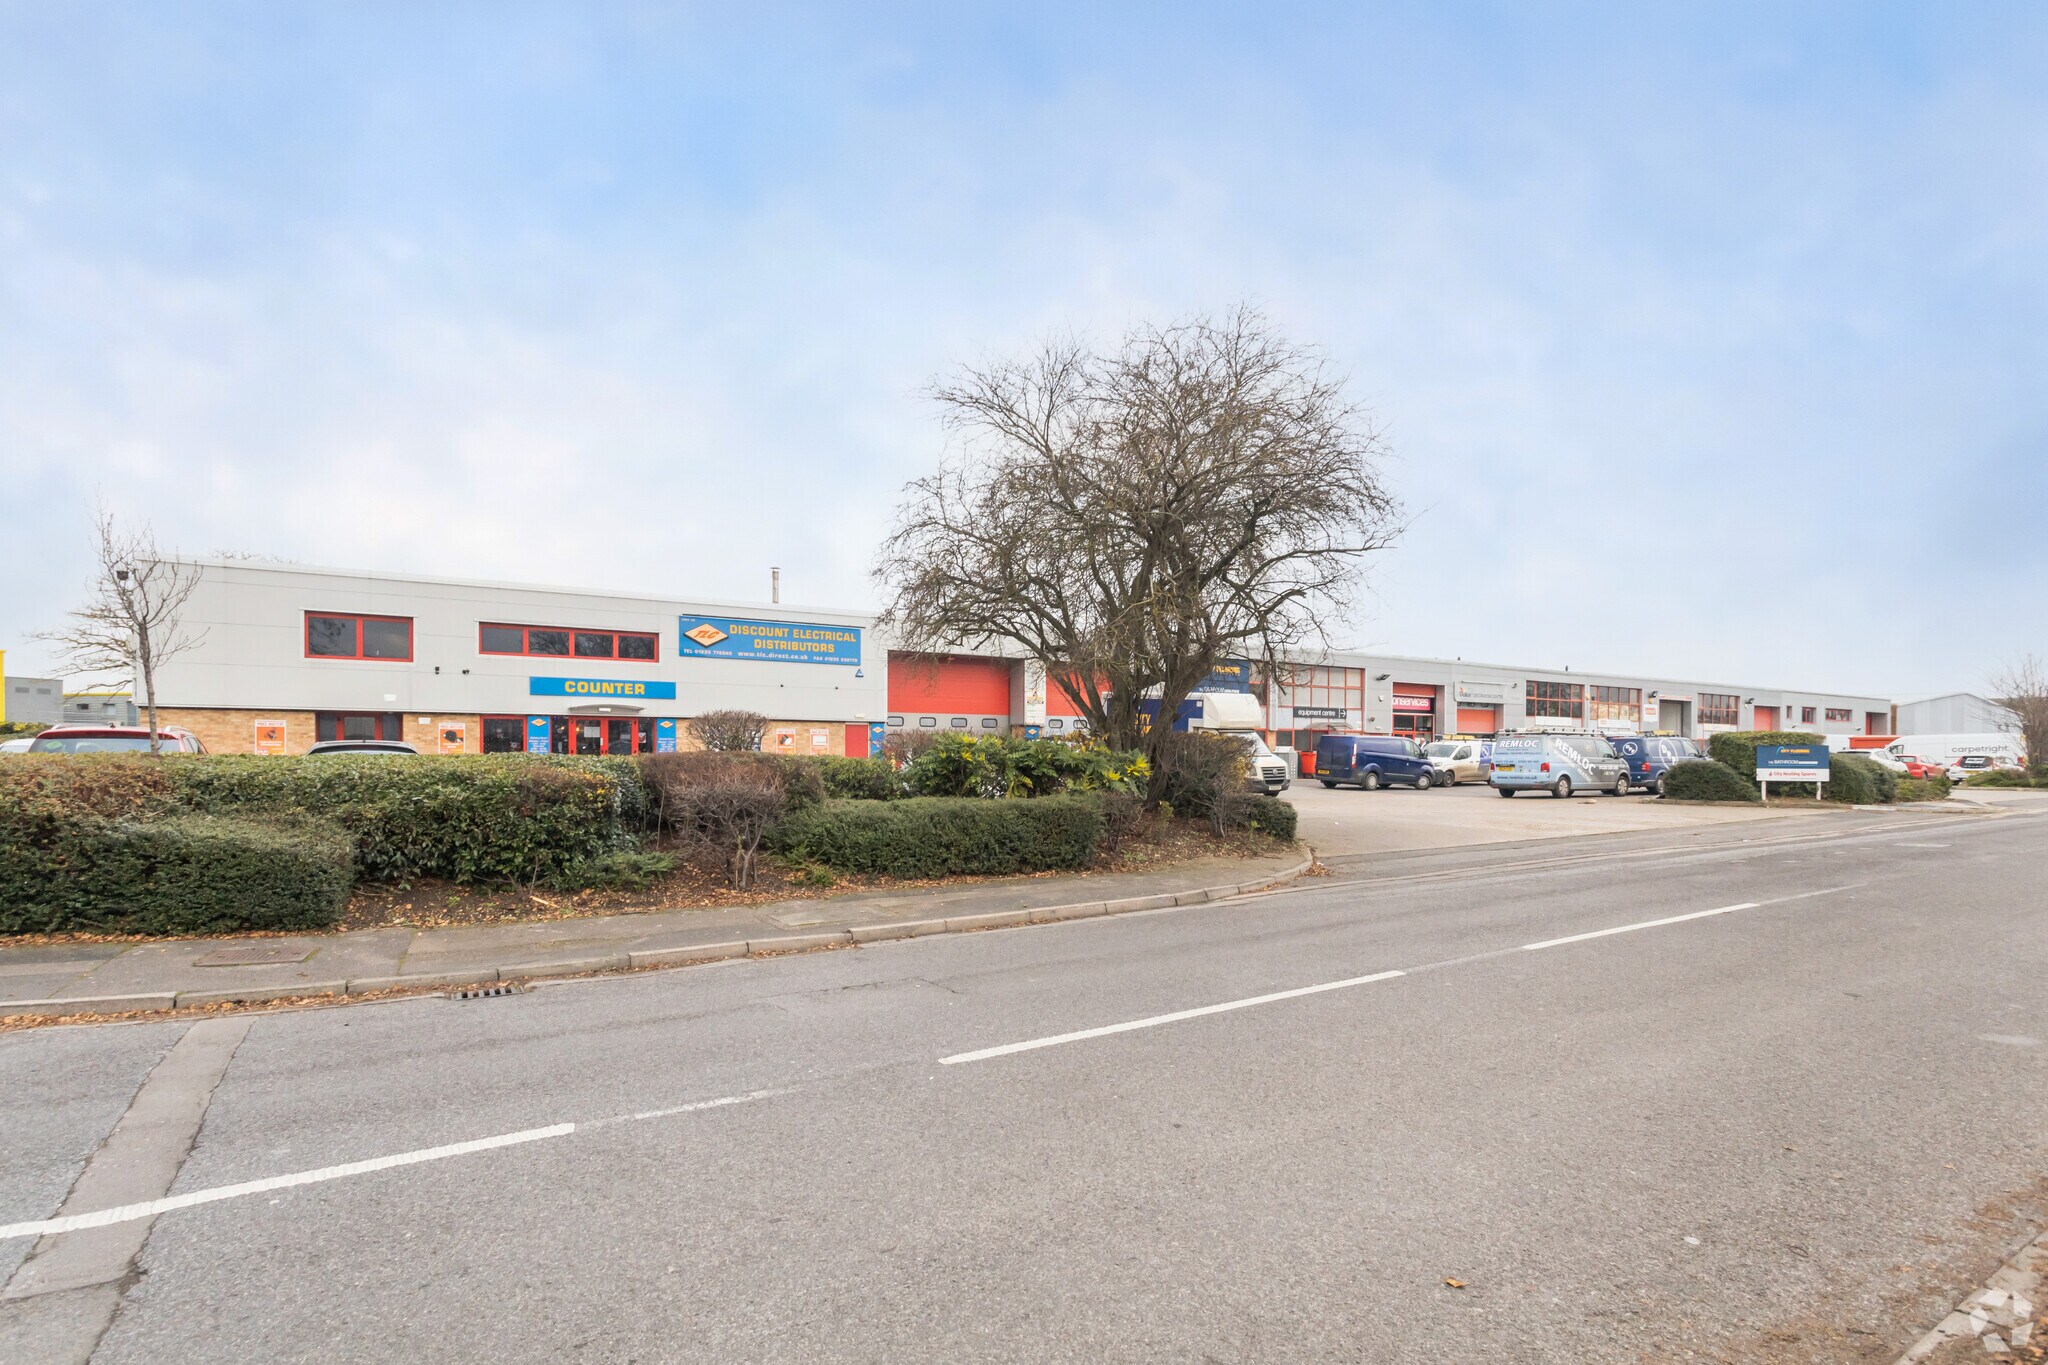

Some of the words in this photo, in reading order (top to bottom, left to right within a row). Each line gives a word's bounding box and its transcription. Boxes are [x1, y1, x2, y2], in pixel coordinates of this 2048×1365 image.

[694, 630, 719, 639] TLC
[729, 624, 789, 637] DISCOUNT
[793, 629, 856, 642] ELECTRICAL
[754, 639, 835, 653] DISTRIBUTORS
[565, 681, 645, 695] COUNTER
[1500, 740, 1539, 748] REMLOC
[1952, 745, 2009, 754] carpetright
[1555, 738, 1596, 776] REMLOC
